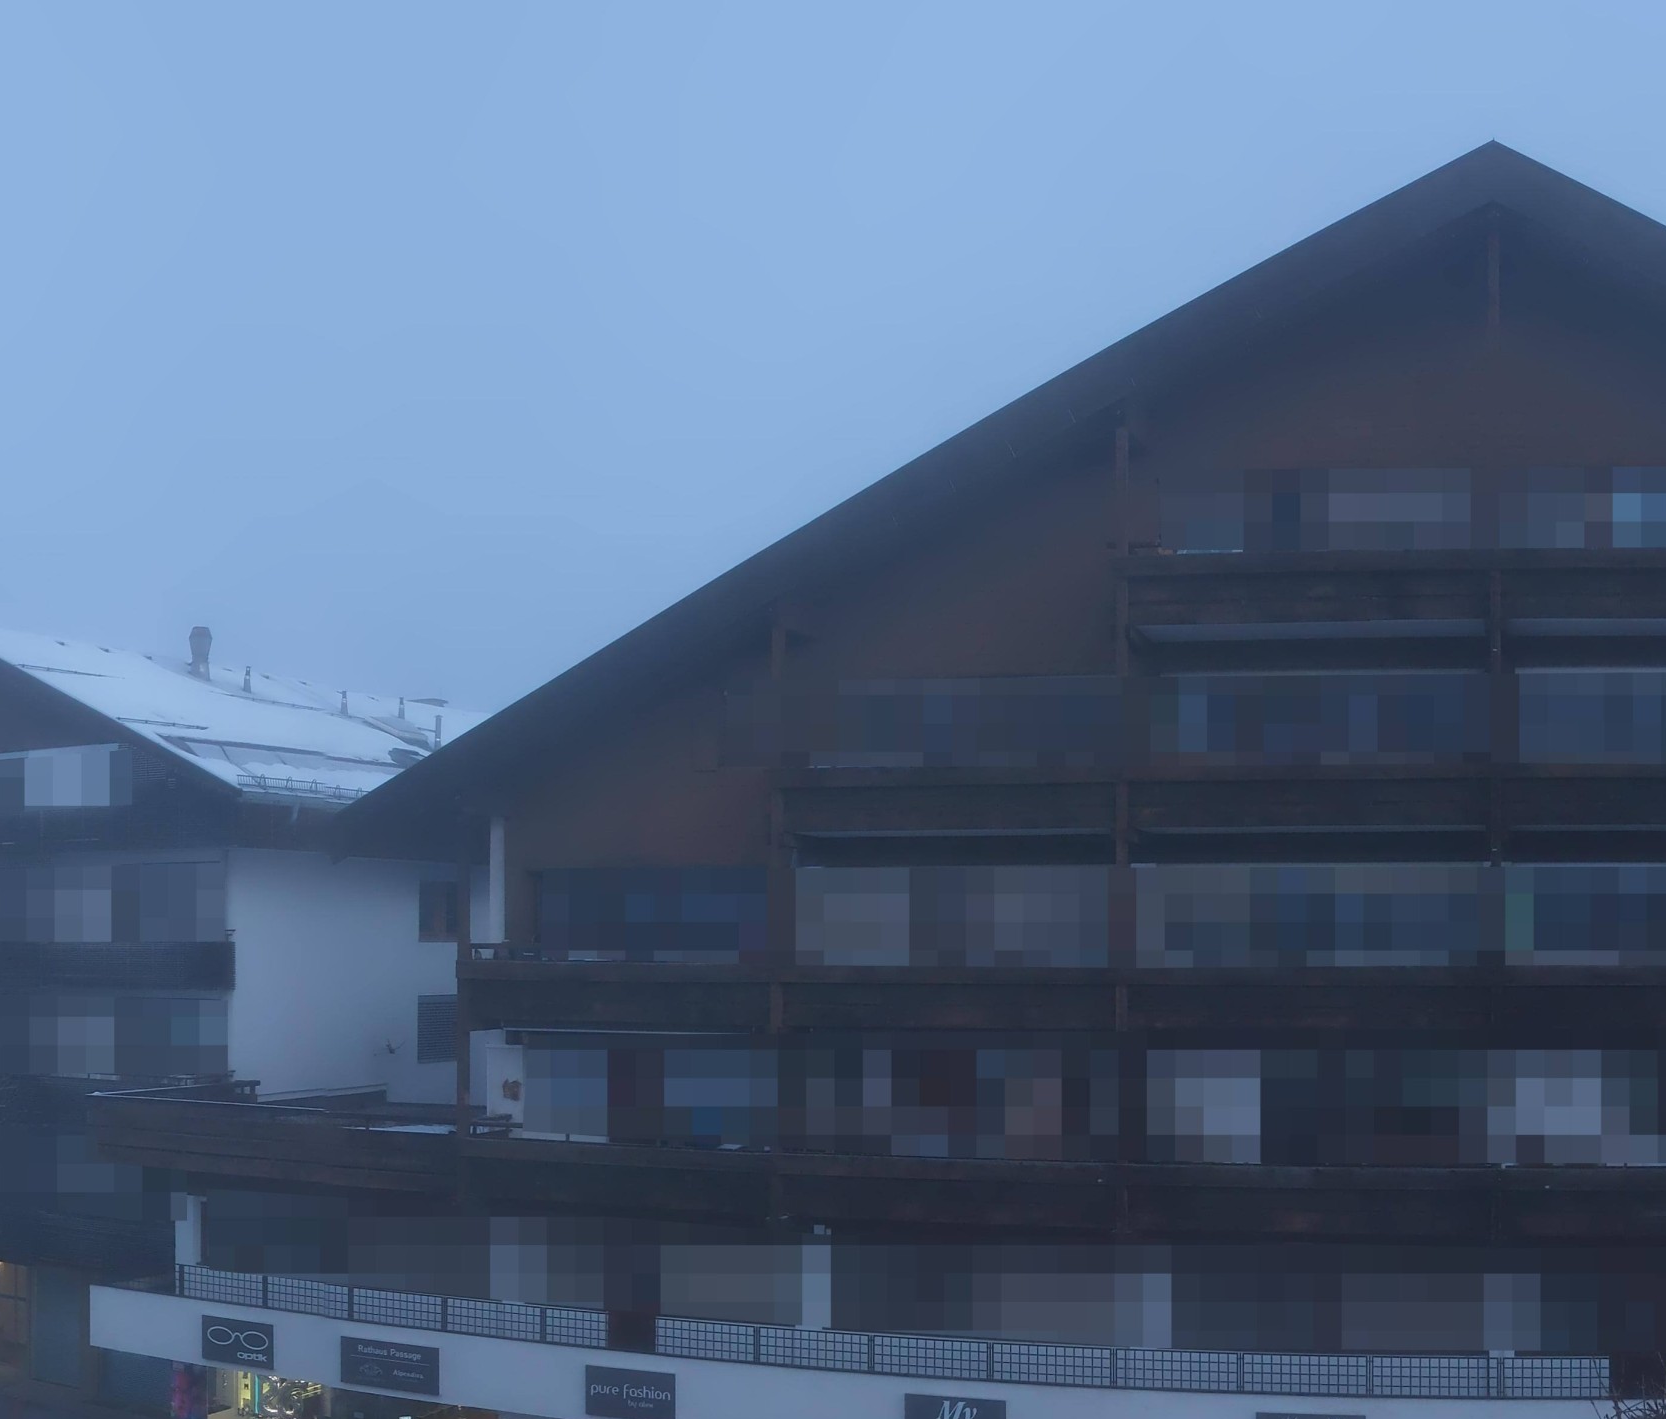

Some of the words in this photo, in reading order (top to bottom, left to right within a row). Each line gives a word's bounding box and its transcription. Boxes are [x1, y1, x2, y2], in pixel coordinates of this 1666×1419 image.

[237, 1351, 267, 1363] optik
[358, 1344, 388, 1355] Rathaus
[390, 1348, 422, 1361] Passage
[590, 1384, 619, 1396] pure
[623, 1383, 671, 1401] fashion
